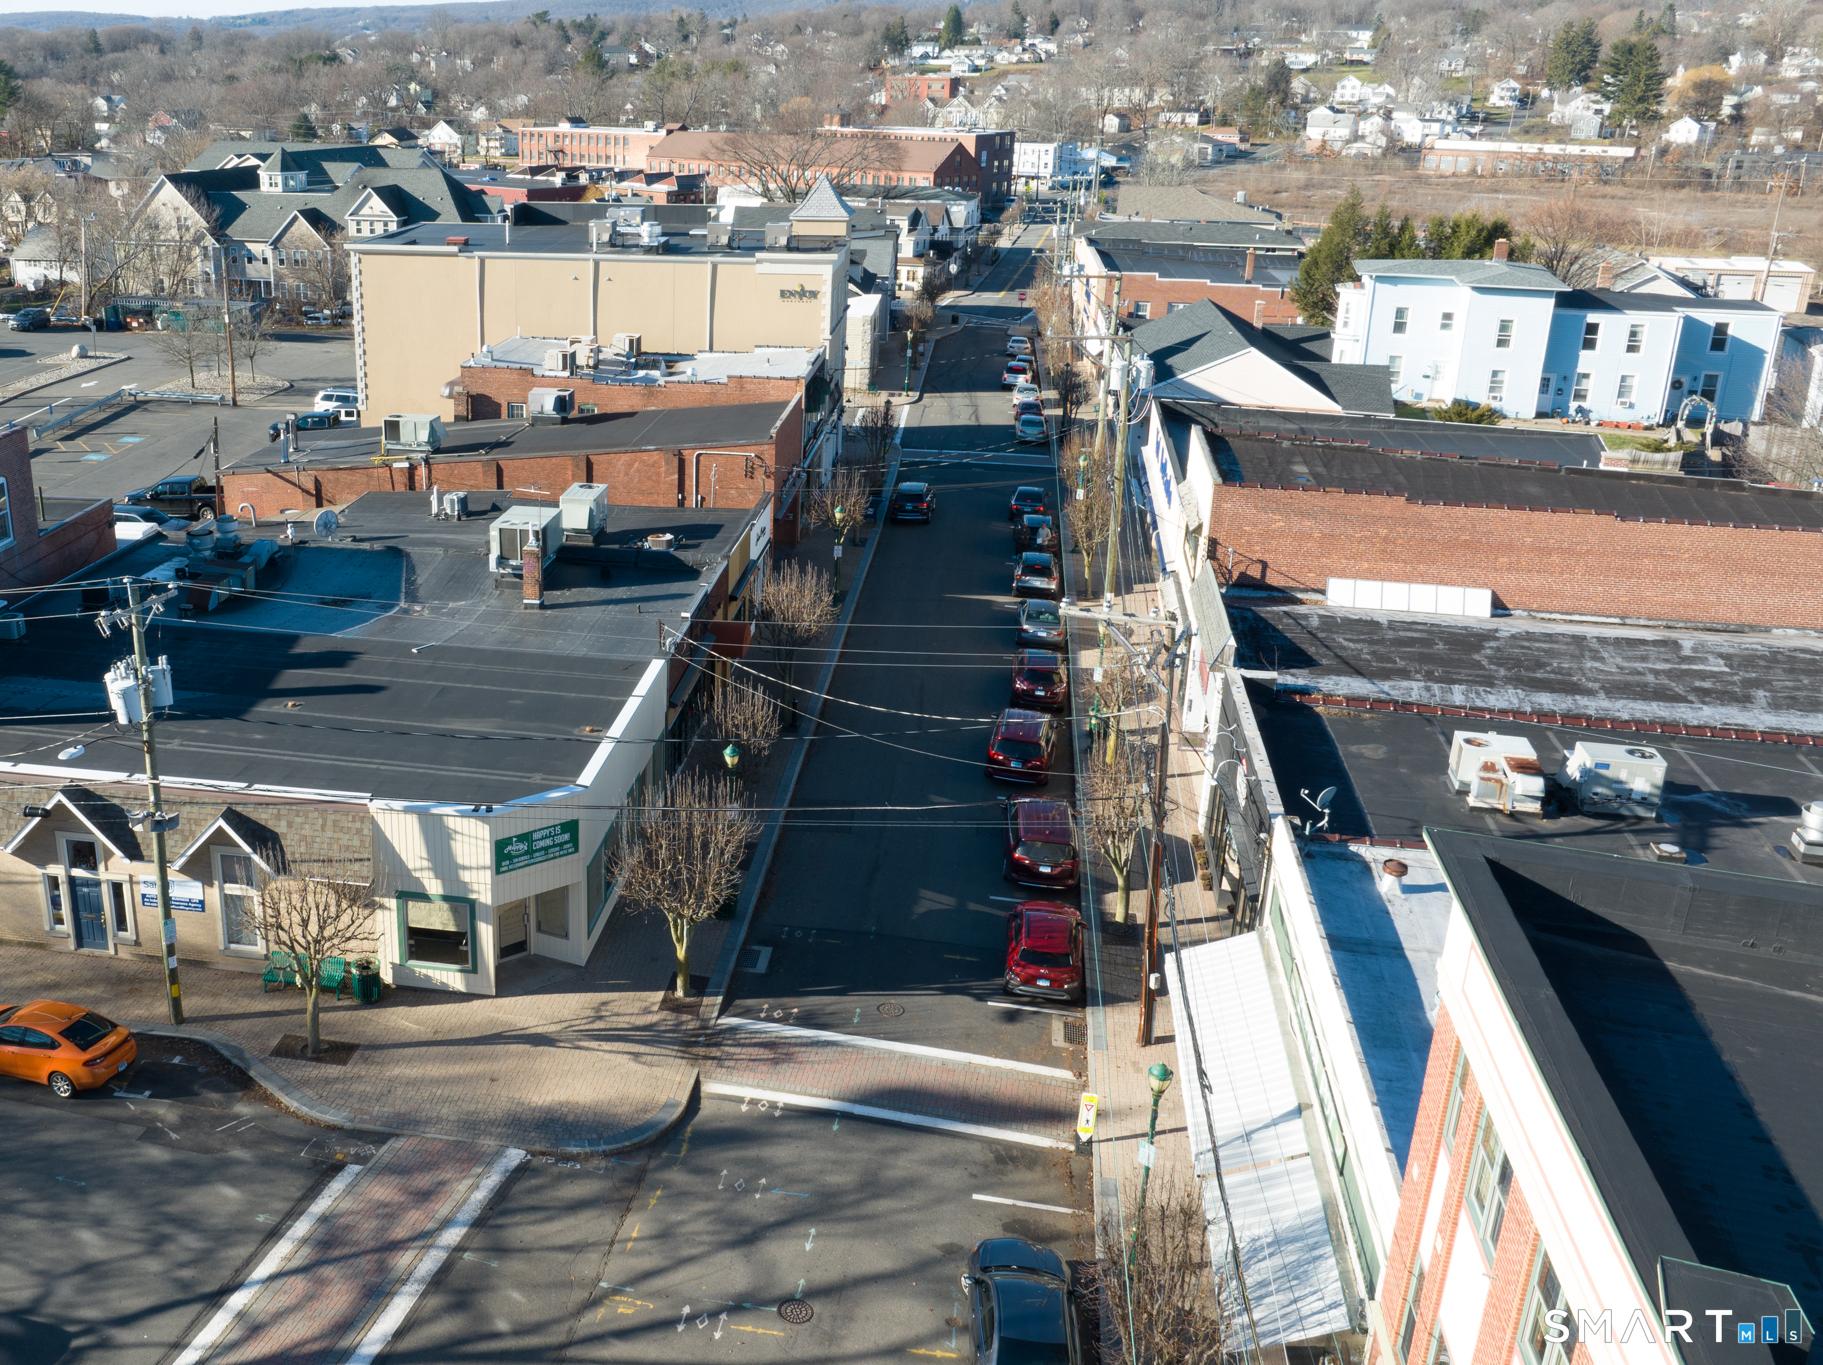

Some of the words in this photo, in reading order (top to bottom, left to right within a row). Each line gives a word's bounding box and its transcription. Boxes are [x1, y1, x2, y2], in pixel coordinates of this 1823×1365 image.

[532, 827, 555, 840] HAPPY'S
[555, 826, 561, 834] IS
[532, 838, 554, 850] COMING
[554, 832, 571, 844] SOON!
